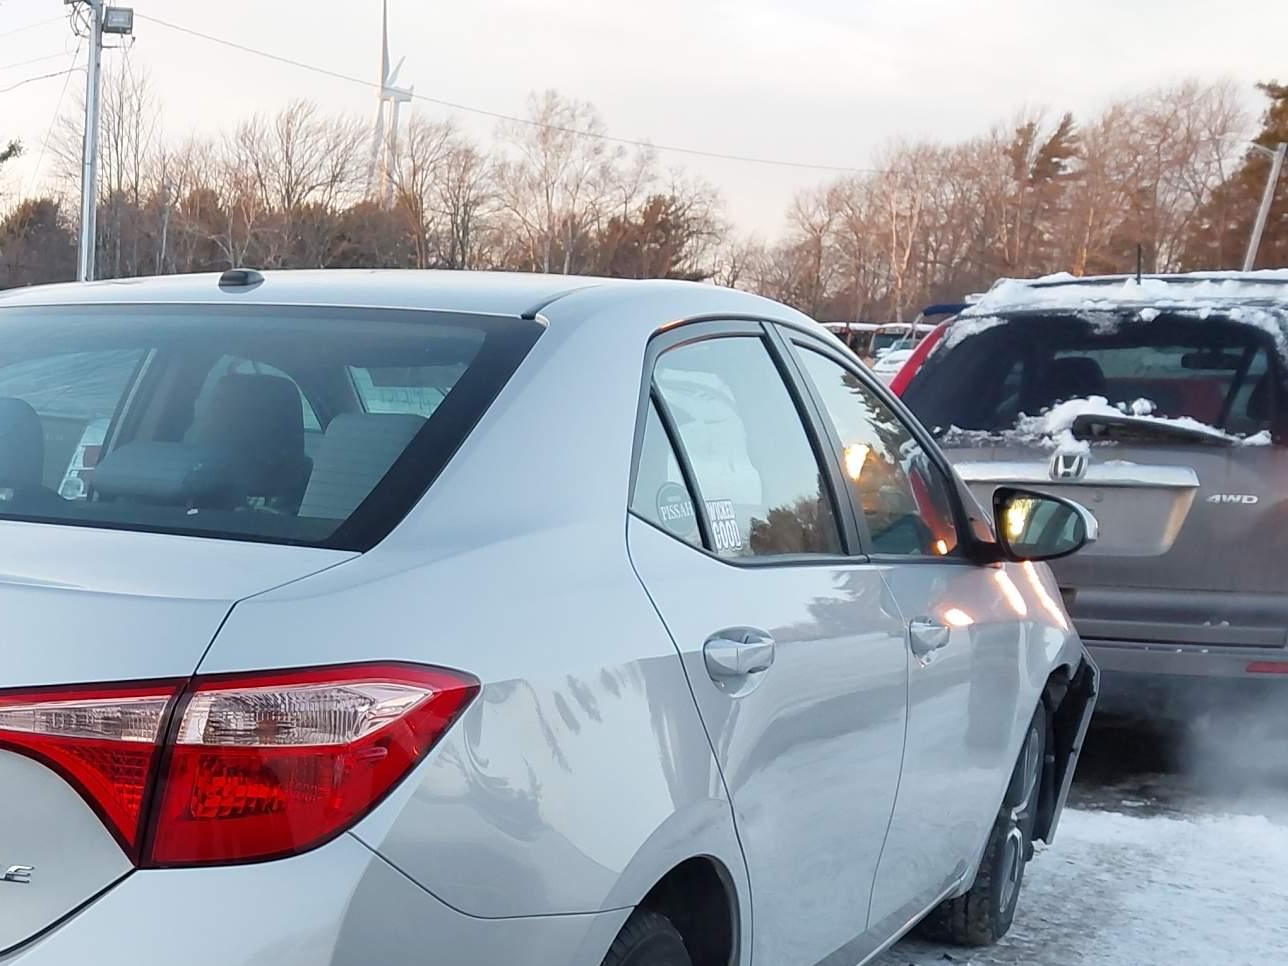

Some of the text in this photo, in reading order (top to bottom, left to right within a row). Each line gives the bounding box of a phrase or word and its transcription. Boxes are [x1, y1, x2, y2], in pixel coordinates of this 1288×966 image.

[1206, 494, 1258, 504] 4WD
[660, 500, 694, 520] PISSAH
[705, 500, 735, 519] WICKED
[712, 520, 742, 550] GOOD
